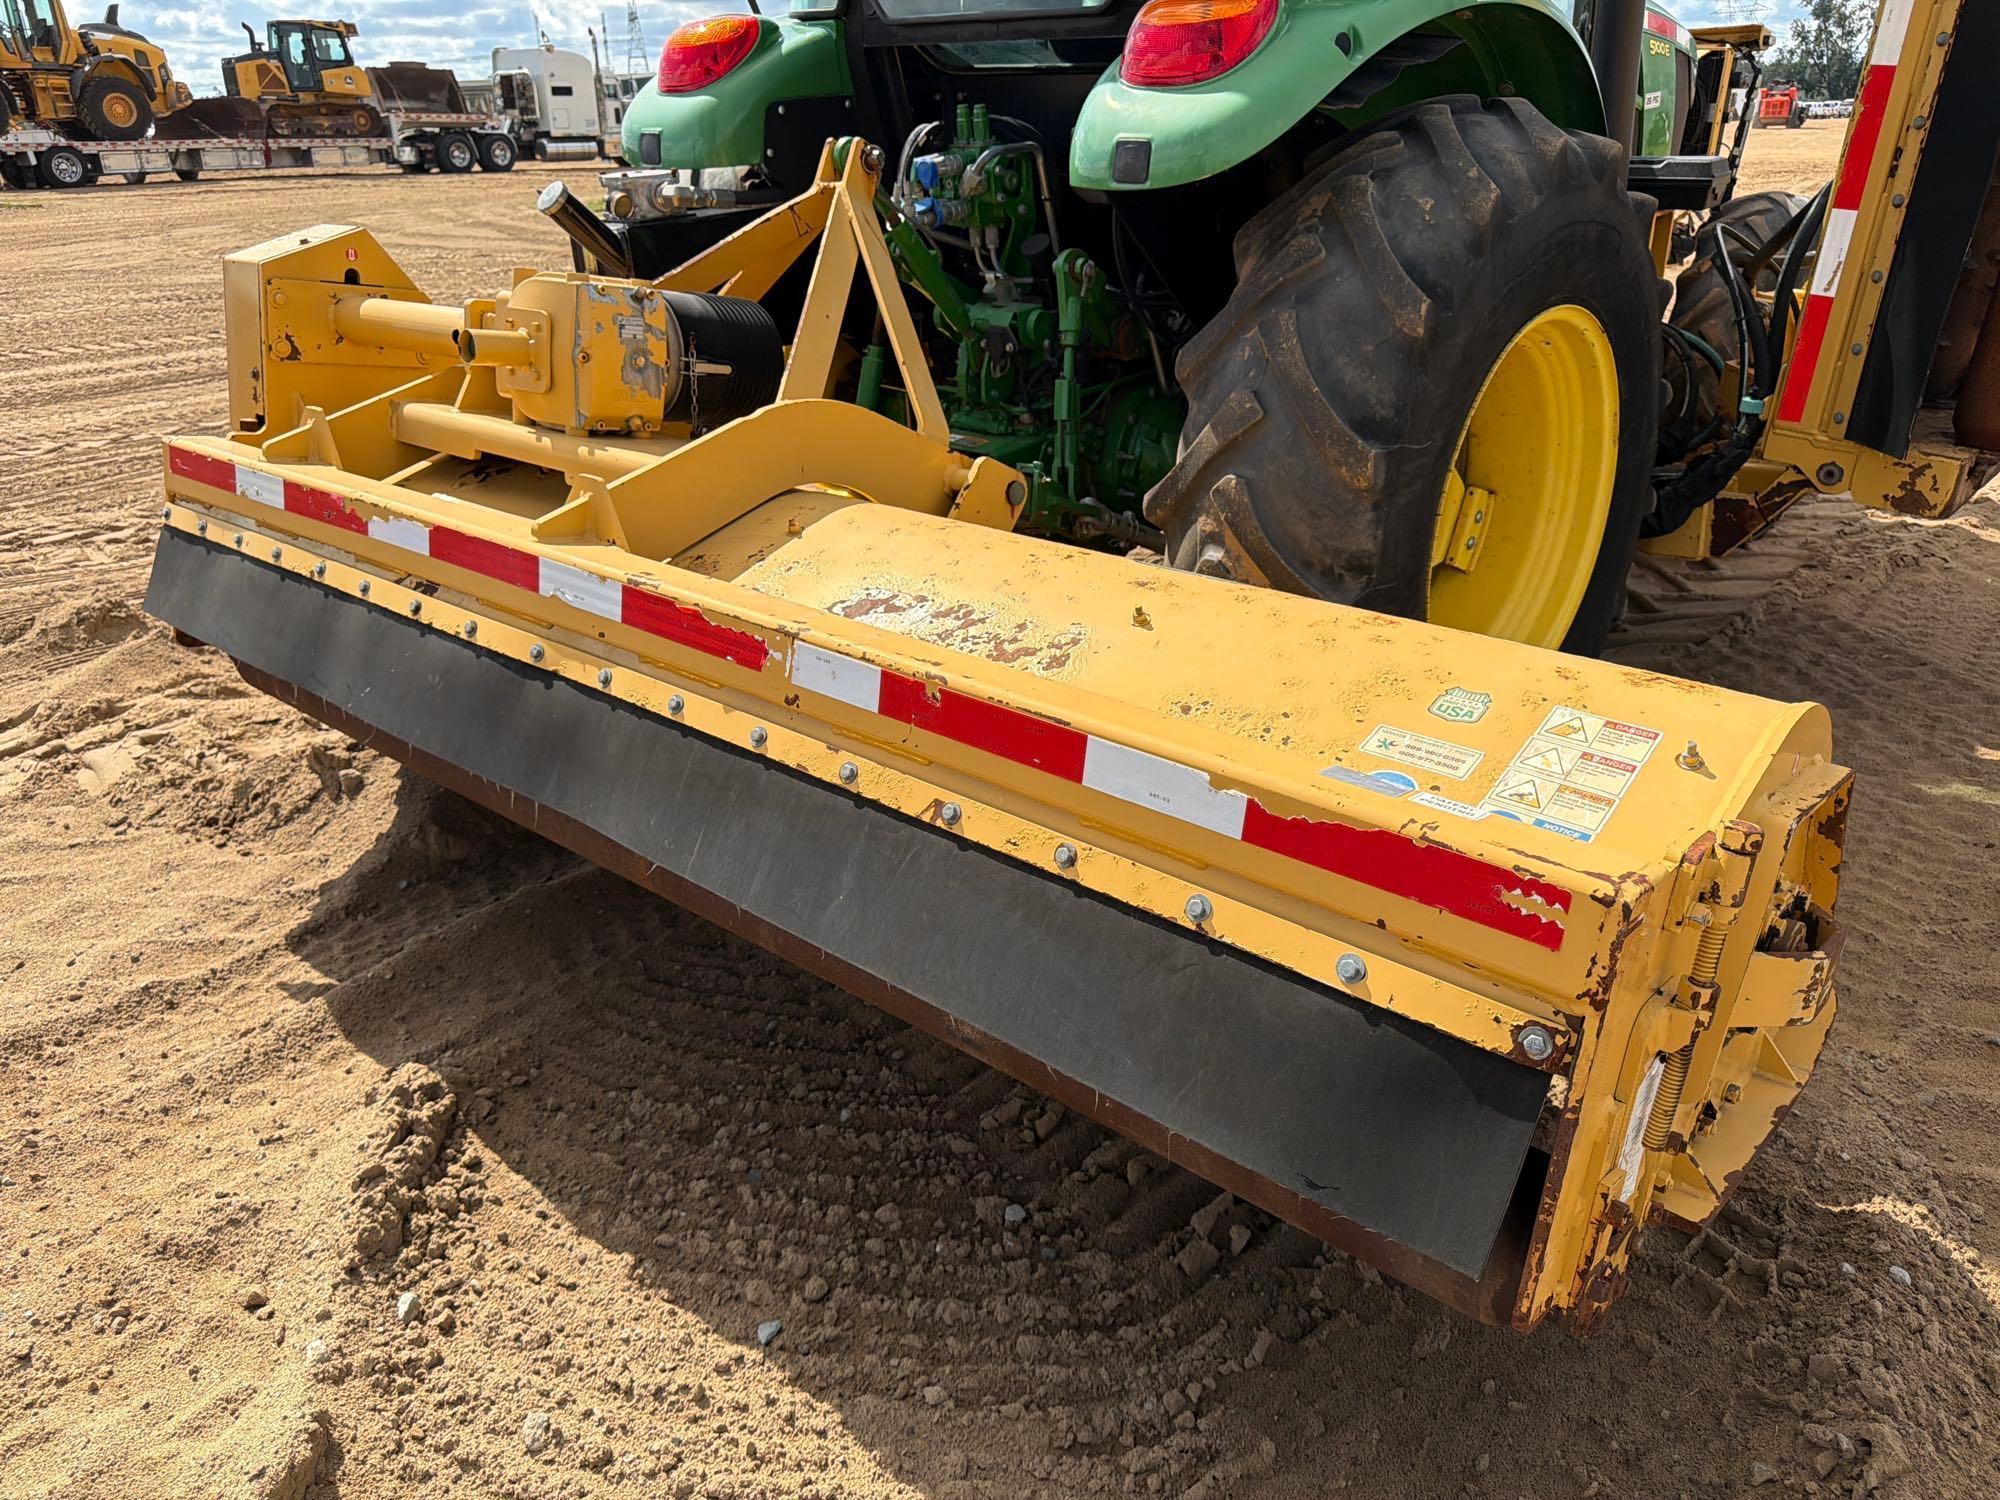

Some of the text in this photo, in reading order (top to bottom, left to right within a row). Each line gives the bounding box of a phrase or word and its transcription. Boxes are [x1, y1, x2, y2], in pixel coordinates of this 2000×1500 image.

[1436, 703, 1475, 719] USA
[1603, 729, 1650, 745] Flying objects
[1615, 724, 1656, 739] DANGER
[1579, 761, 1627, 777] Sharp objects
[1592, 755, 1634, 771] DANGER
[1431, 796, 1474, 811] PATENT
[1569, 787, 1613, 806] WARNING
[1420, 798, 1476, 817] PENDING
[1580, 801, 1606, 811] operate
[1542, 822, 1582, 838] NOTICE
